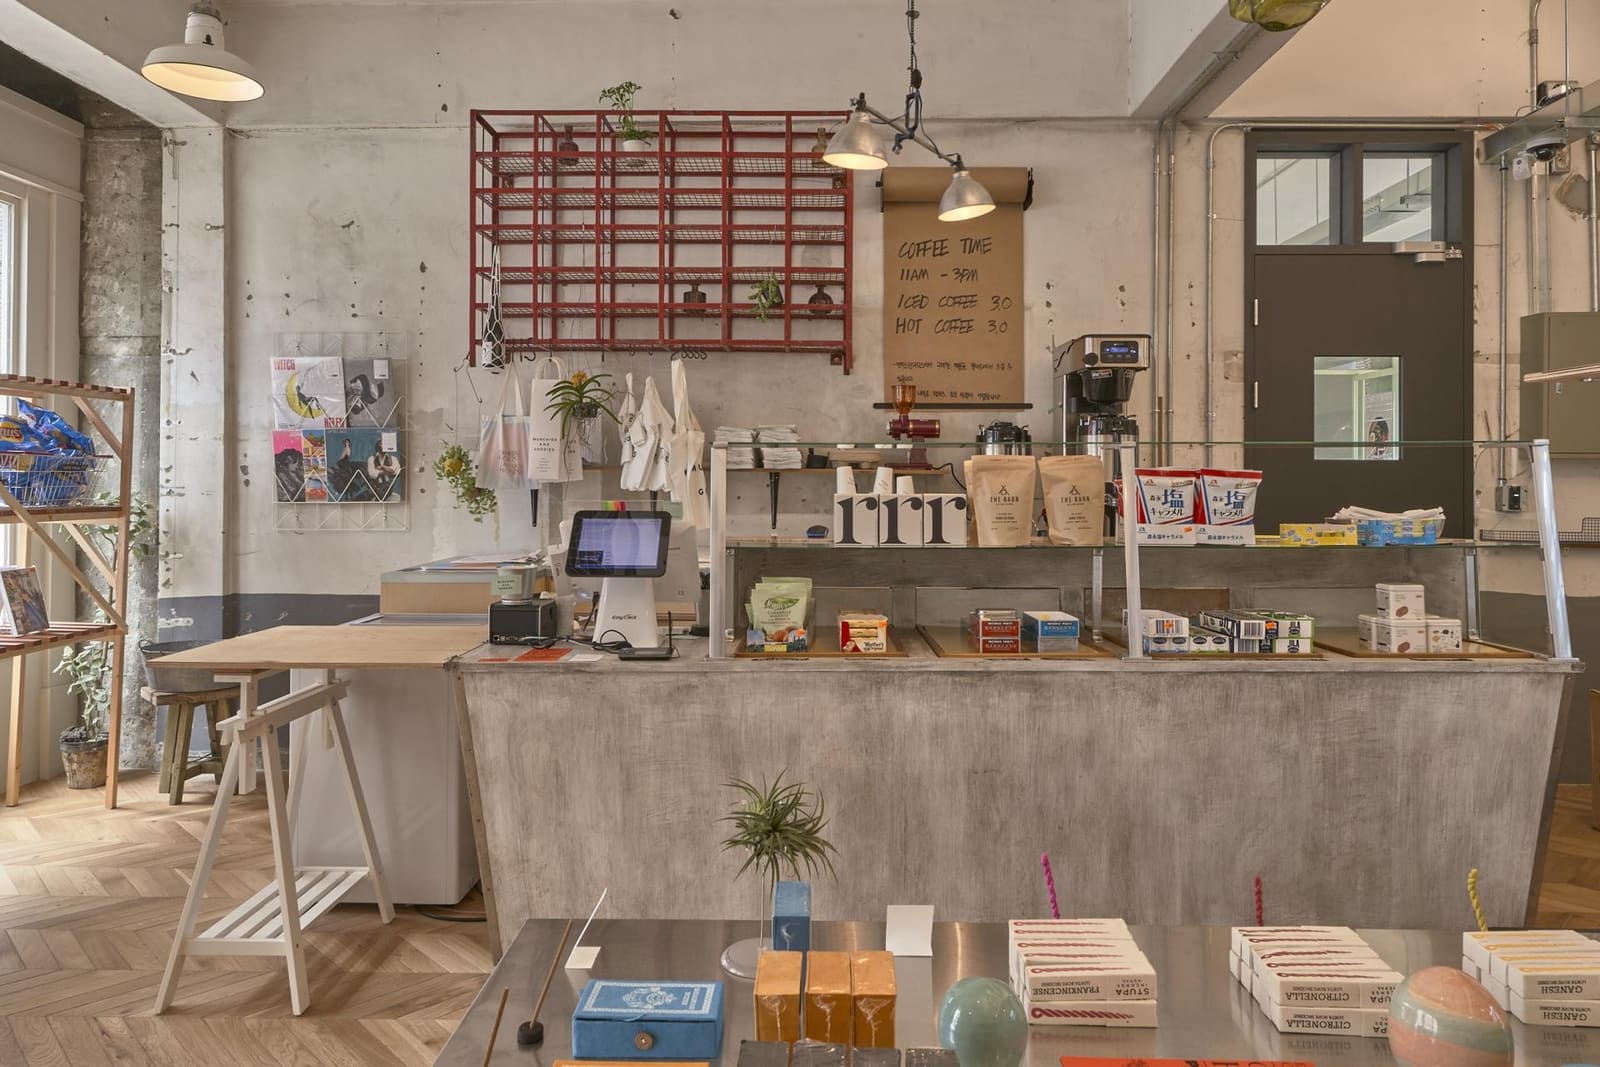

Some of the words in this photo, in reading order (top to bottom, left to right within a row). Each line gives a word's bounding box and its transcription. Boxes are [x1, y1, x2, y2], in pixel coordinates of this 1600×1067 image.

[898, 238, 950, 260] COFFEE
[960, 237, 993, 255] TIME
[900, 268, 929, 281] 11AM
[898, 293, 929, 309] ICED
[938, 294, 978, 309] COFFEE
[896, 317, 923, 334] HOT
[935, 318, 974, 334] COFFEE
[1161, 488, 1184, 508] 塩
[1150, 507, 1184, 517] キャラメル
[1211, 507, 1244, 518] キャラメル
[1033, 986, 1100, 996] FRANKINCENSE
[1115, 988, 1150, 996] STUPA
[1541, 985, 1583, 994] GANESH
[1285, 992, 1350, 1001] CITRONELLA
[1370, 995, 1391, 1003] UPA
[1543, 1011, 1588, 1021] GANESH
[1287, 1019, 1352, 1029] CITRONELLA
